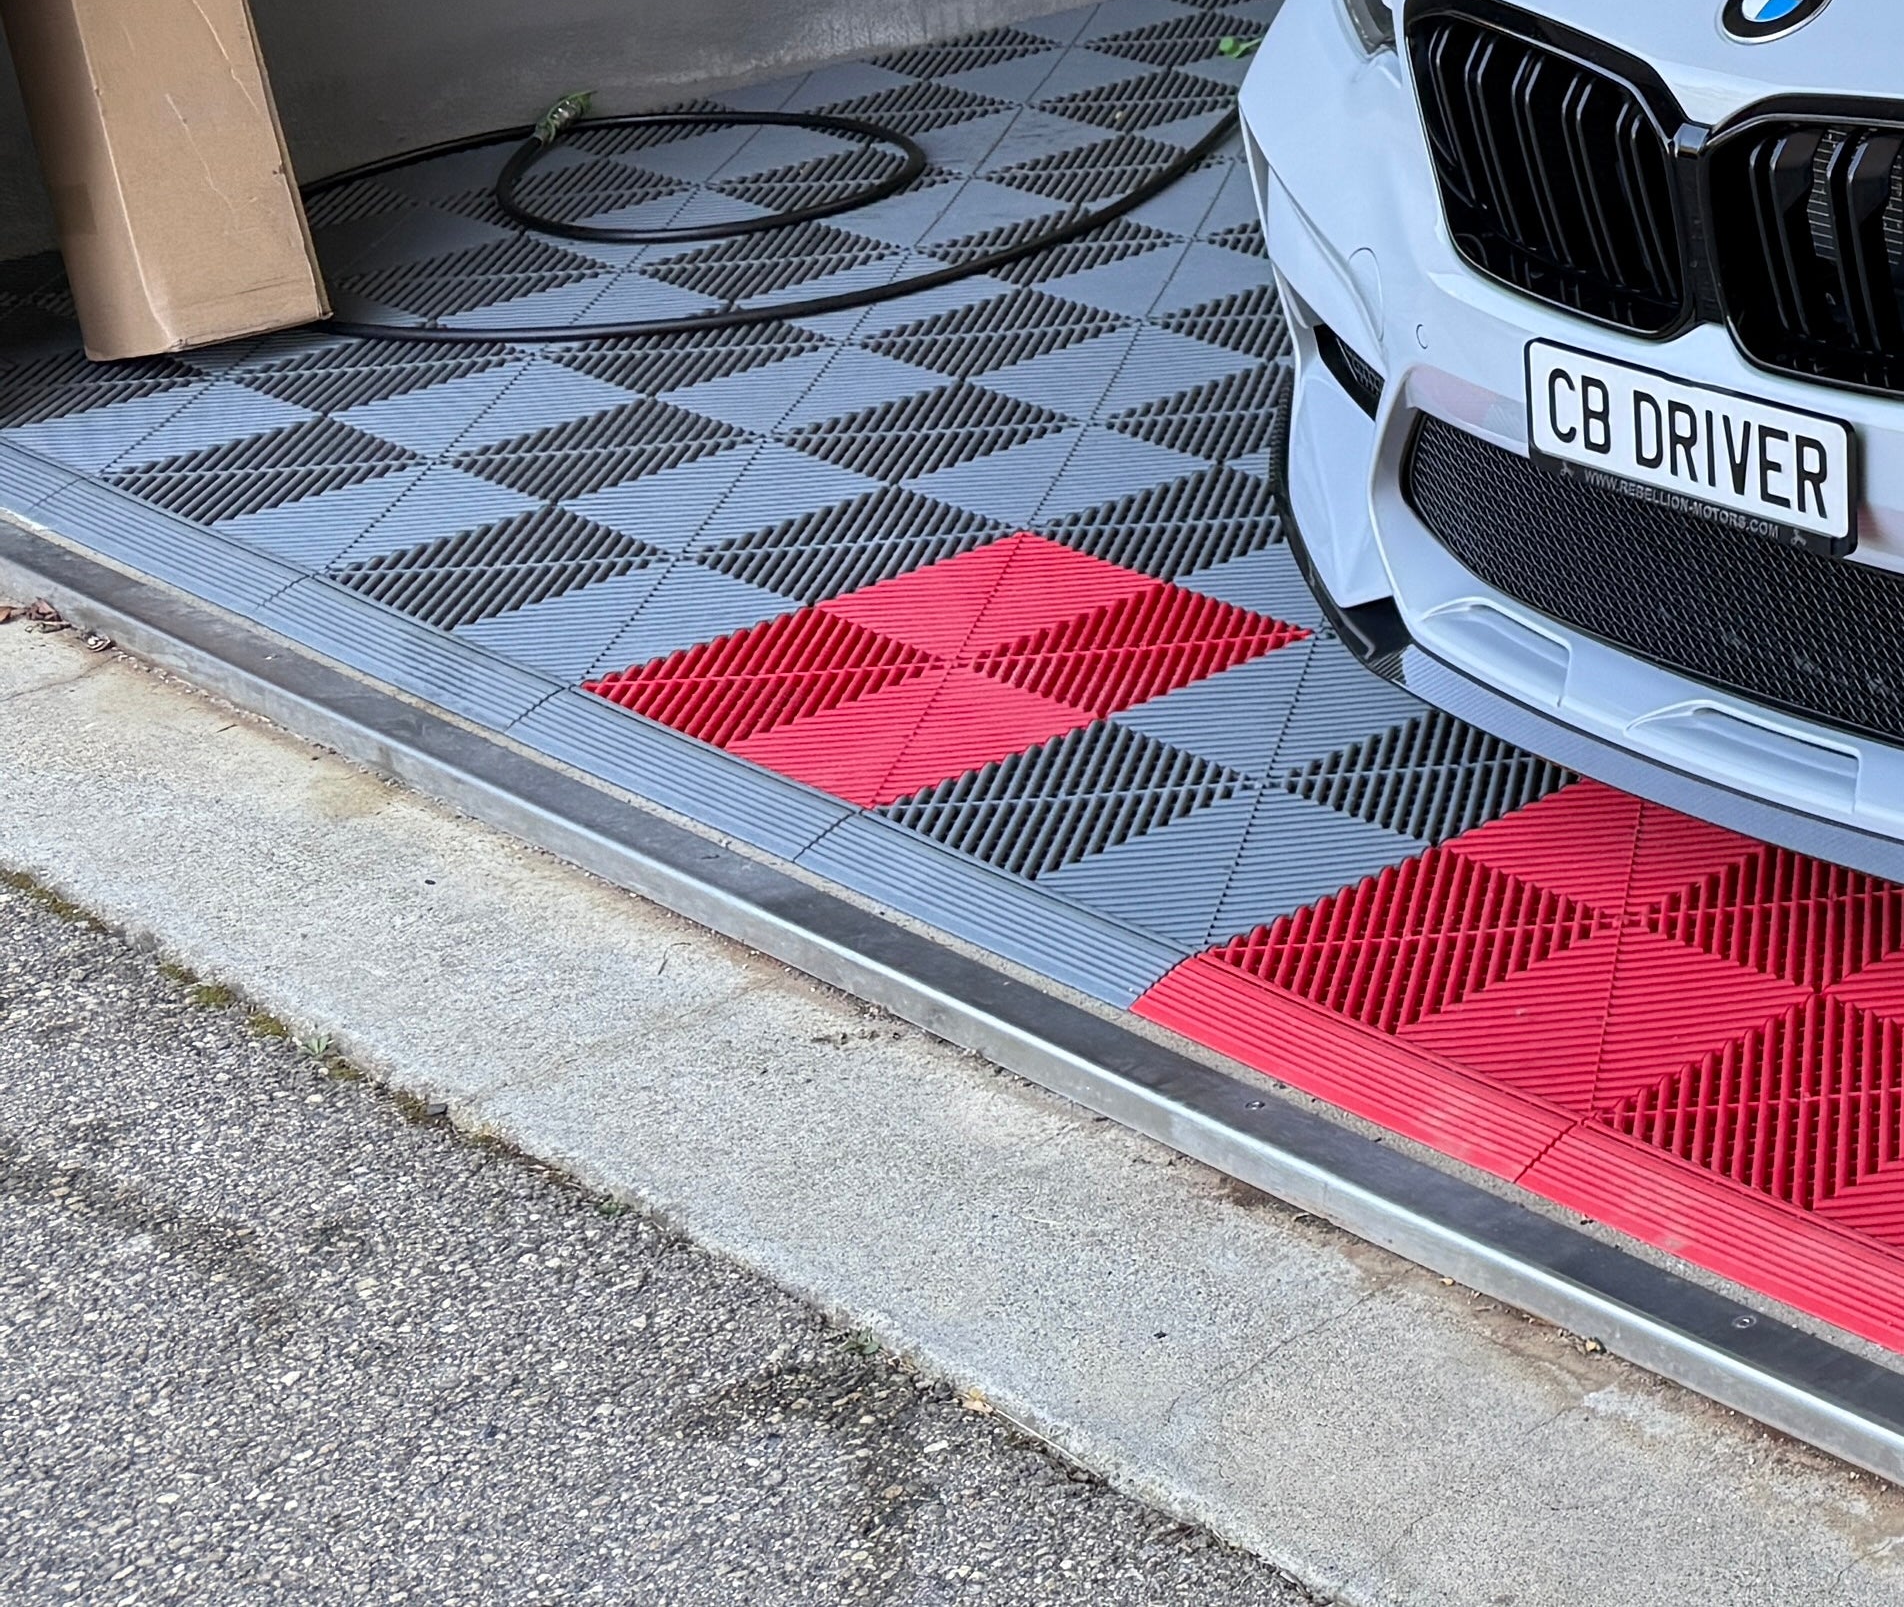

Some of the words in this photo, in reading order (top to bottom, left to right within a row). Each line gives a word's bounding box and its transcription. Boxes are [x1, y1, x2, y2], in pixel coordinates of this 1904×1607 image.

[1548, 367, 1612, 455] CB
[1633, 389, 1828, 520] DRIVER
[1584, 470, 1780, 540] WWW.REBELLION-MOTORS.COM
